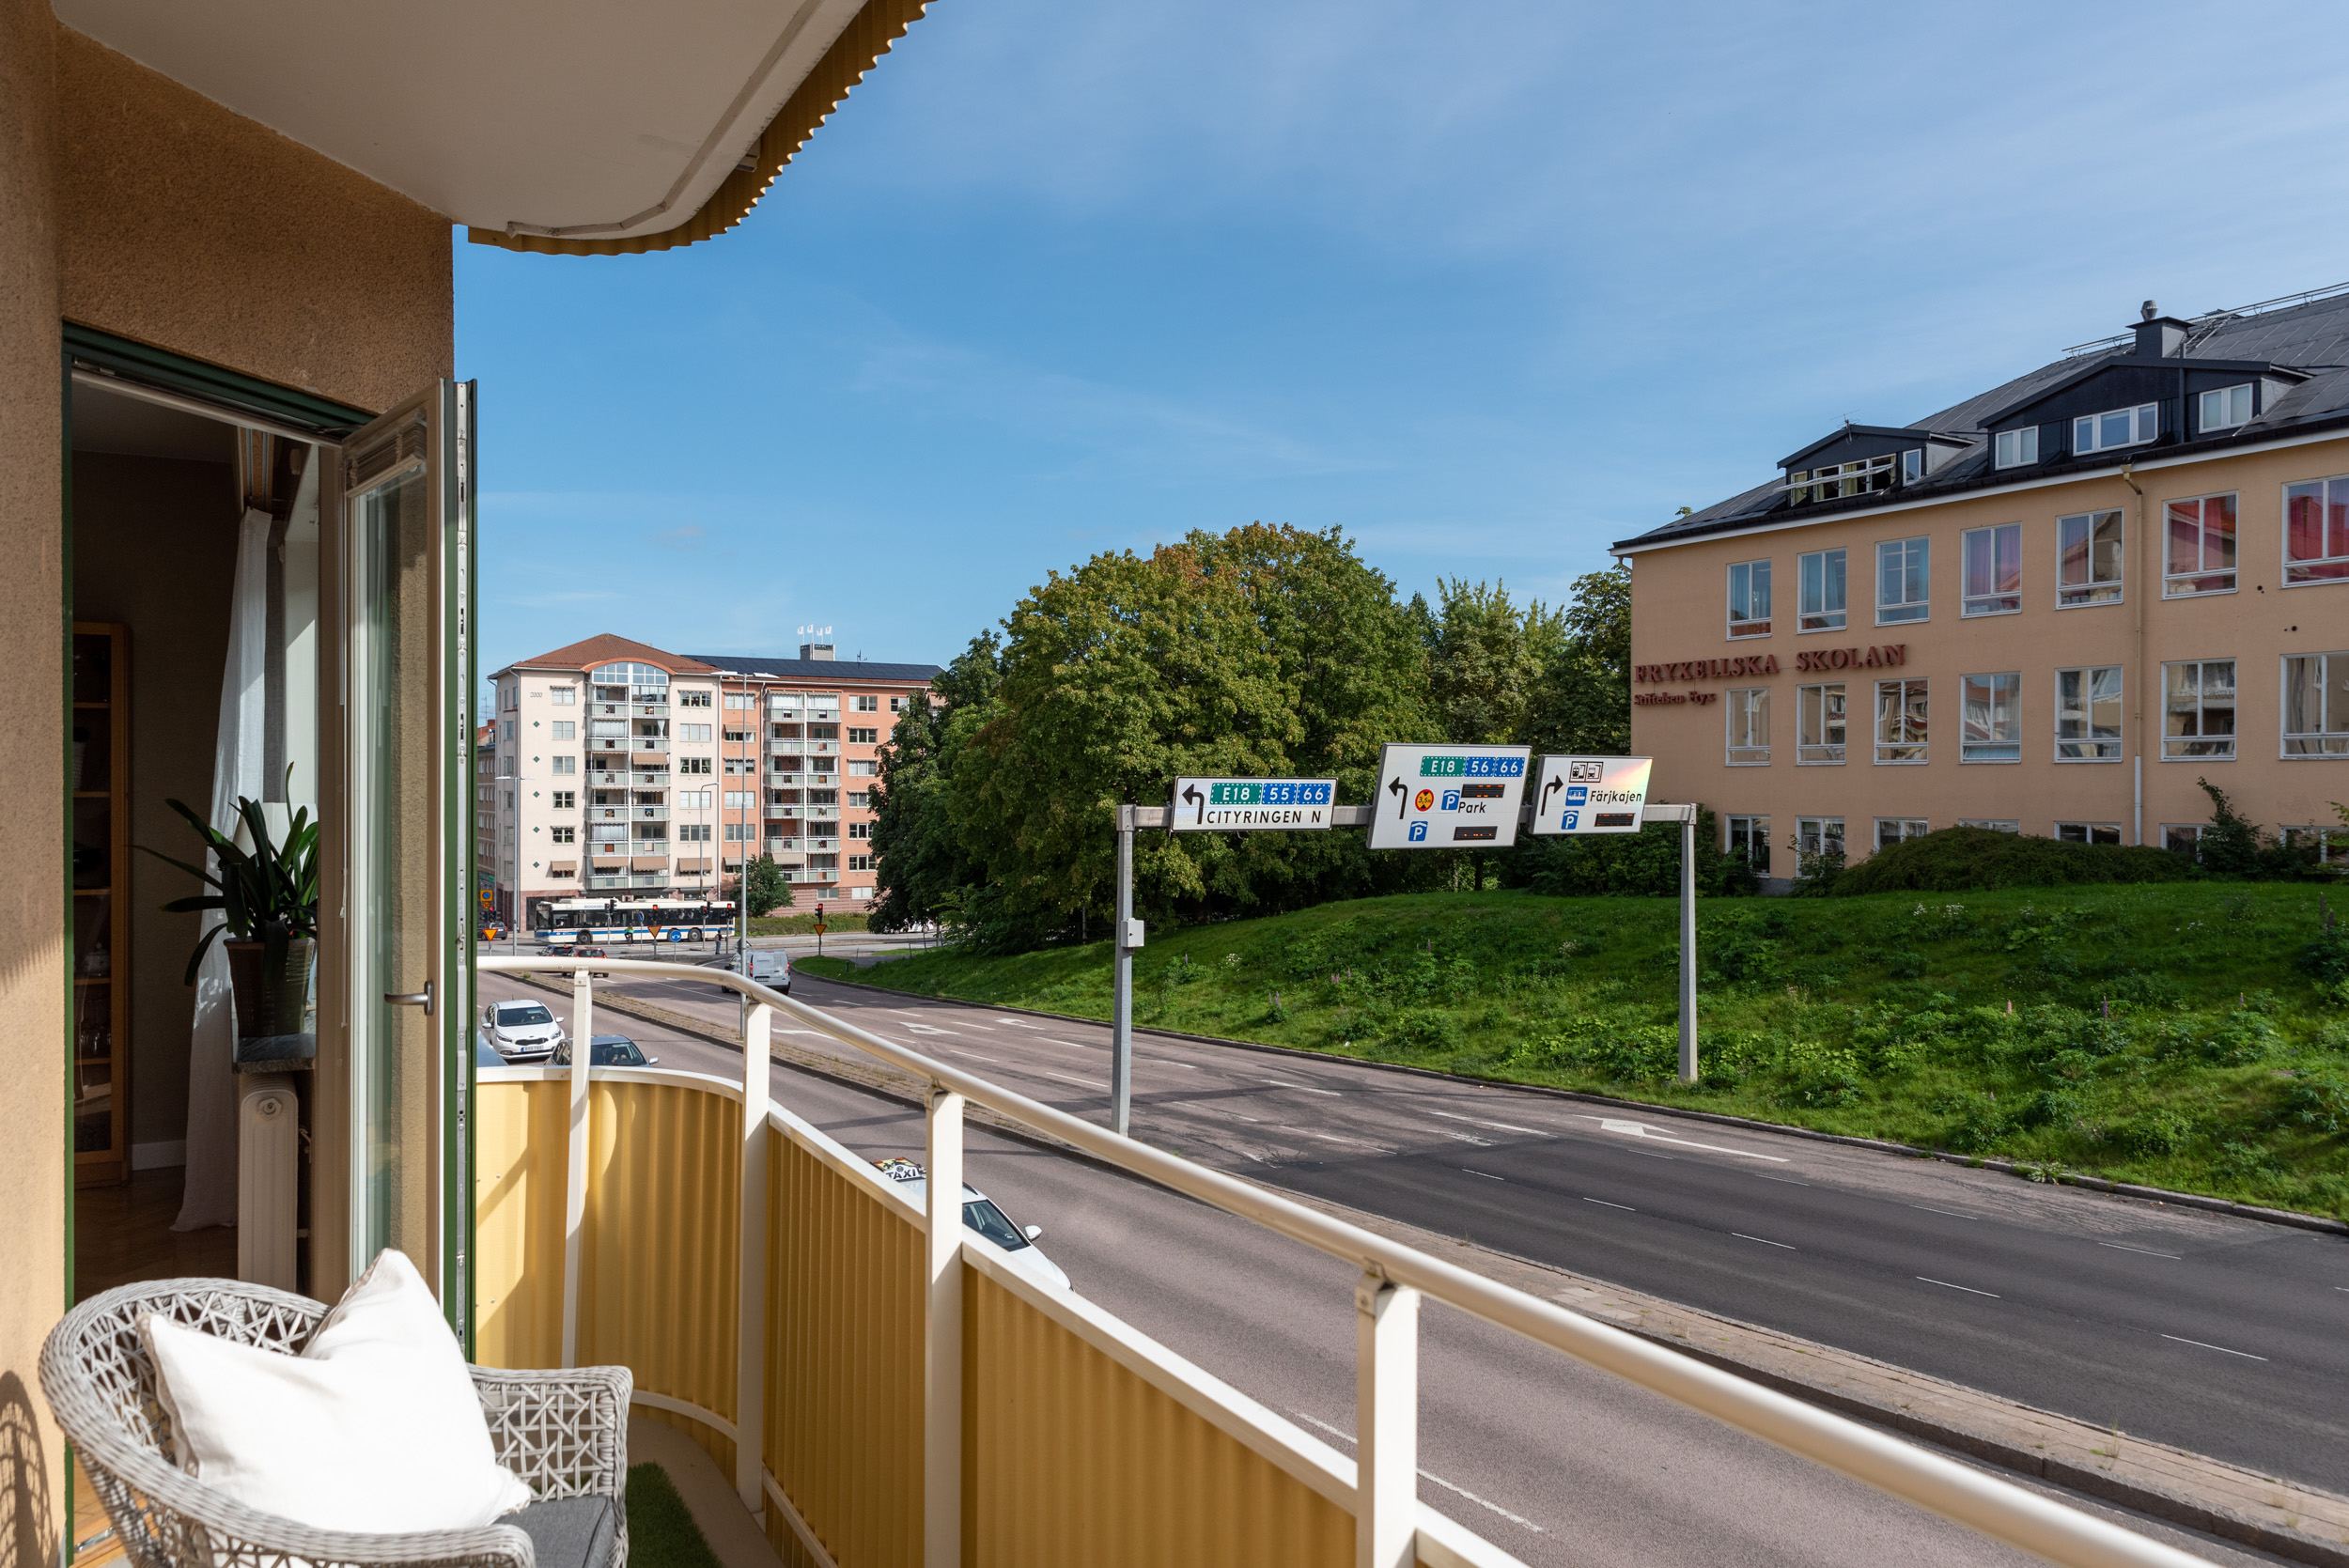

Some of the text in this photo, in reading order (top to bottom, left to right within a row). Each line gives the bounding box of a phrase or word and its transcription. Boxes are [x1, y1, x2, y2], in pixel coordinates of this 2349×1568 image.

[1634, 644, 1906, 683] FRYXELLSKA SKOLAN
[1634, 692, 1686, 705] Stiftelsen
[1431, 760, 1518, 773] E18 56 66
[1222, 787, 1324, 800] E18 55 66
[1590, 790, 1642, 804] Färjkajen
[1446, 796, 1456, 810] P
[1458, 801, 1486, 814] Park
[1207, 811, 1321, 824] CITYRINGEN N
[1565, 815, 1575, 829] P
[1413, 827, 1423, 840] P
[886, 1169, 916, 1179] TAXI
